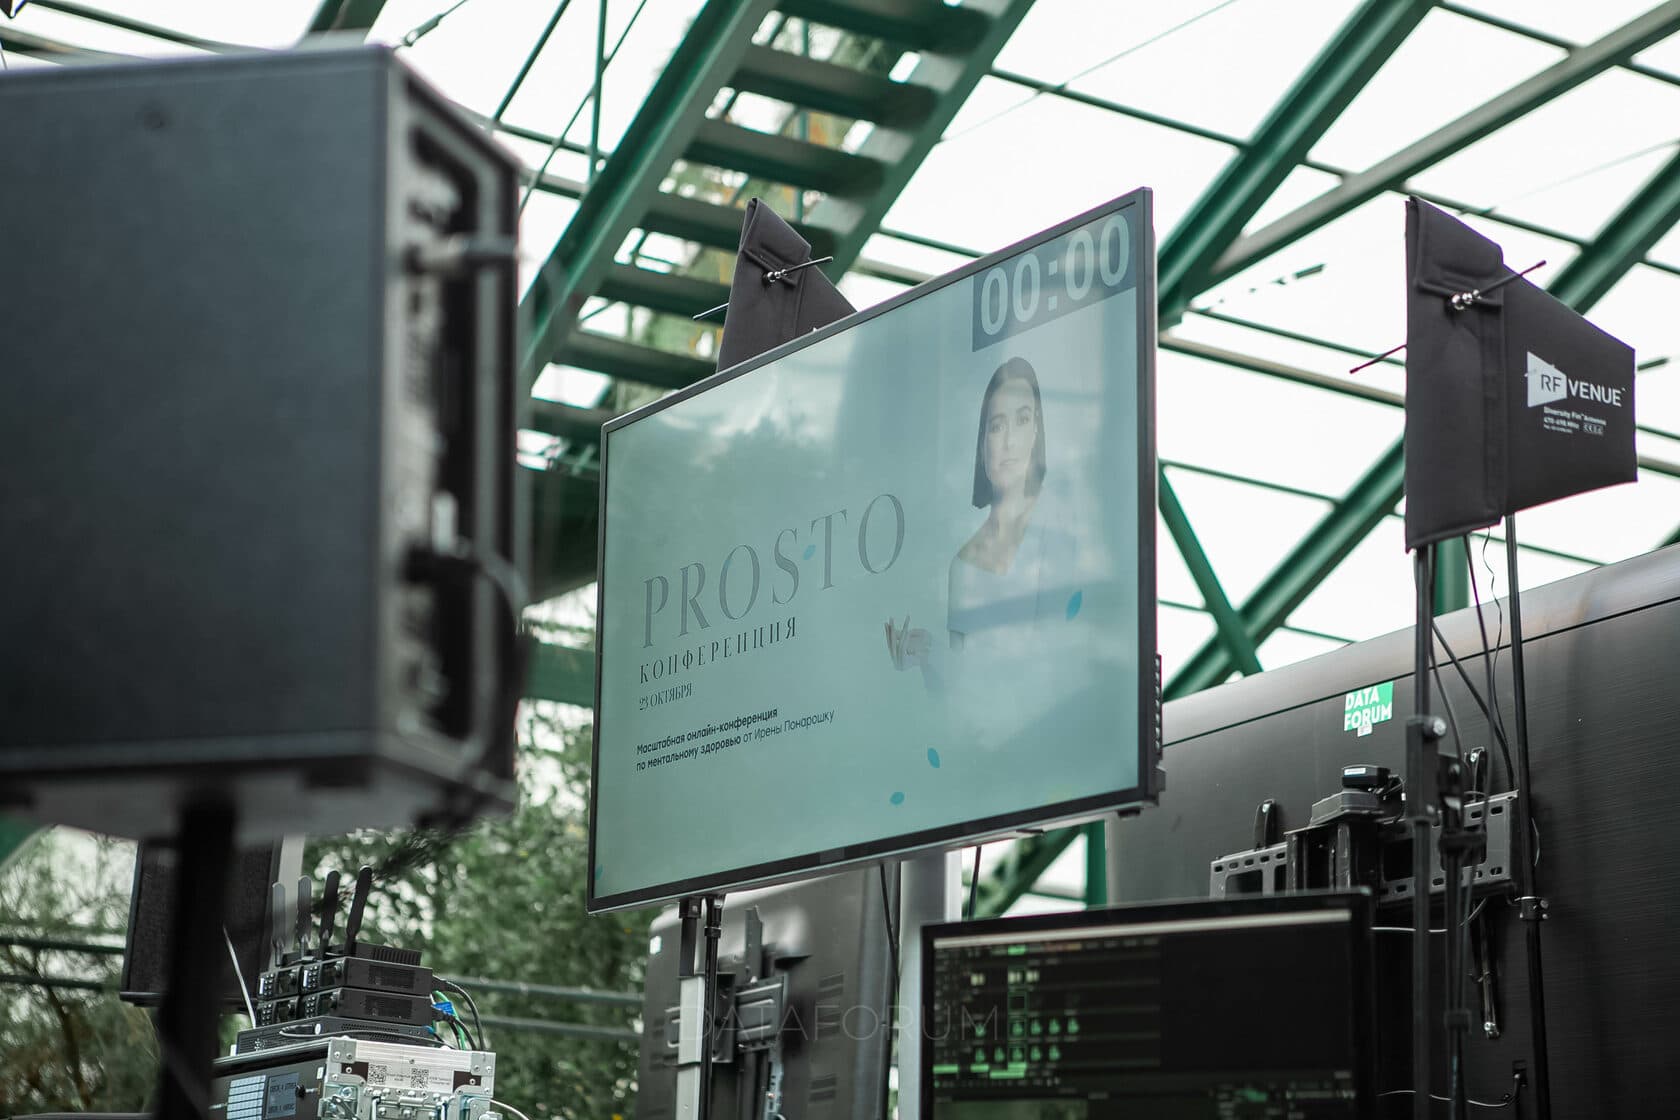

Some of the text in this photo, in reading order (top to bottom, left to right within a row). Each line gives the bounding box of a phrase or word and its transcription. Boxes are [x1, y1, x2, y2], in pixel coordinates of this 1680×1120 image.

[980, 214, 1130, 336] 00:00
[1541, 374, 1562, 392] RF
[642, 493, 906, 649] PROSTO
[640, 616, 797, 684] КОНФЕРЕНЦИЯ
[639, 682, 693, 711] 23 ОКТЯБРЯ
[1344, 702, 1393, 732] FORUM
[1345, 686, 1380, 711] DATA
[636, 709, 835, 772] по ментальному здоровью от Ирены Понарошку
[637, 708, 778, 755] Масштабная онлайн-конференция
